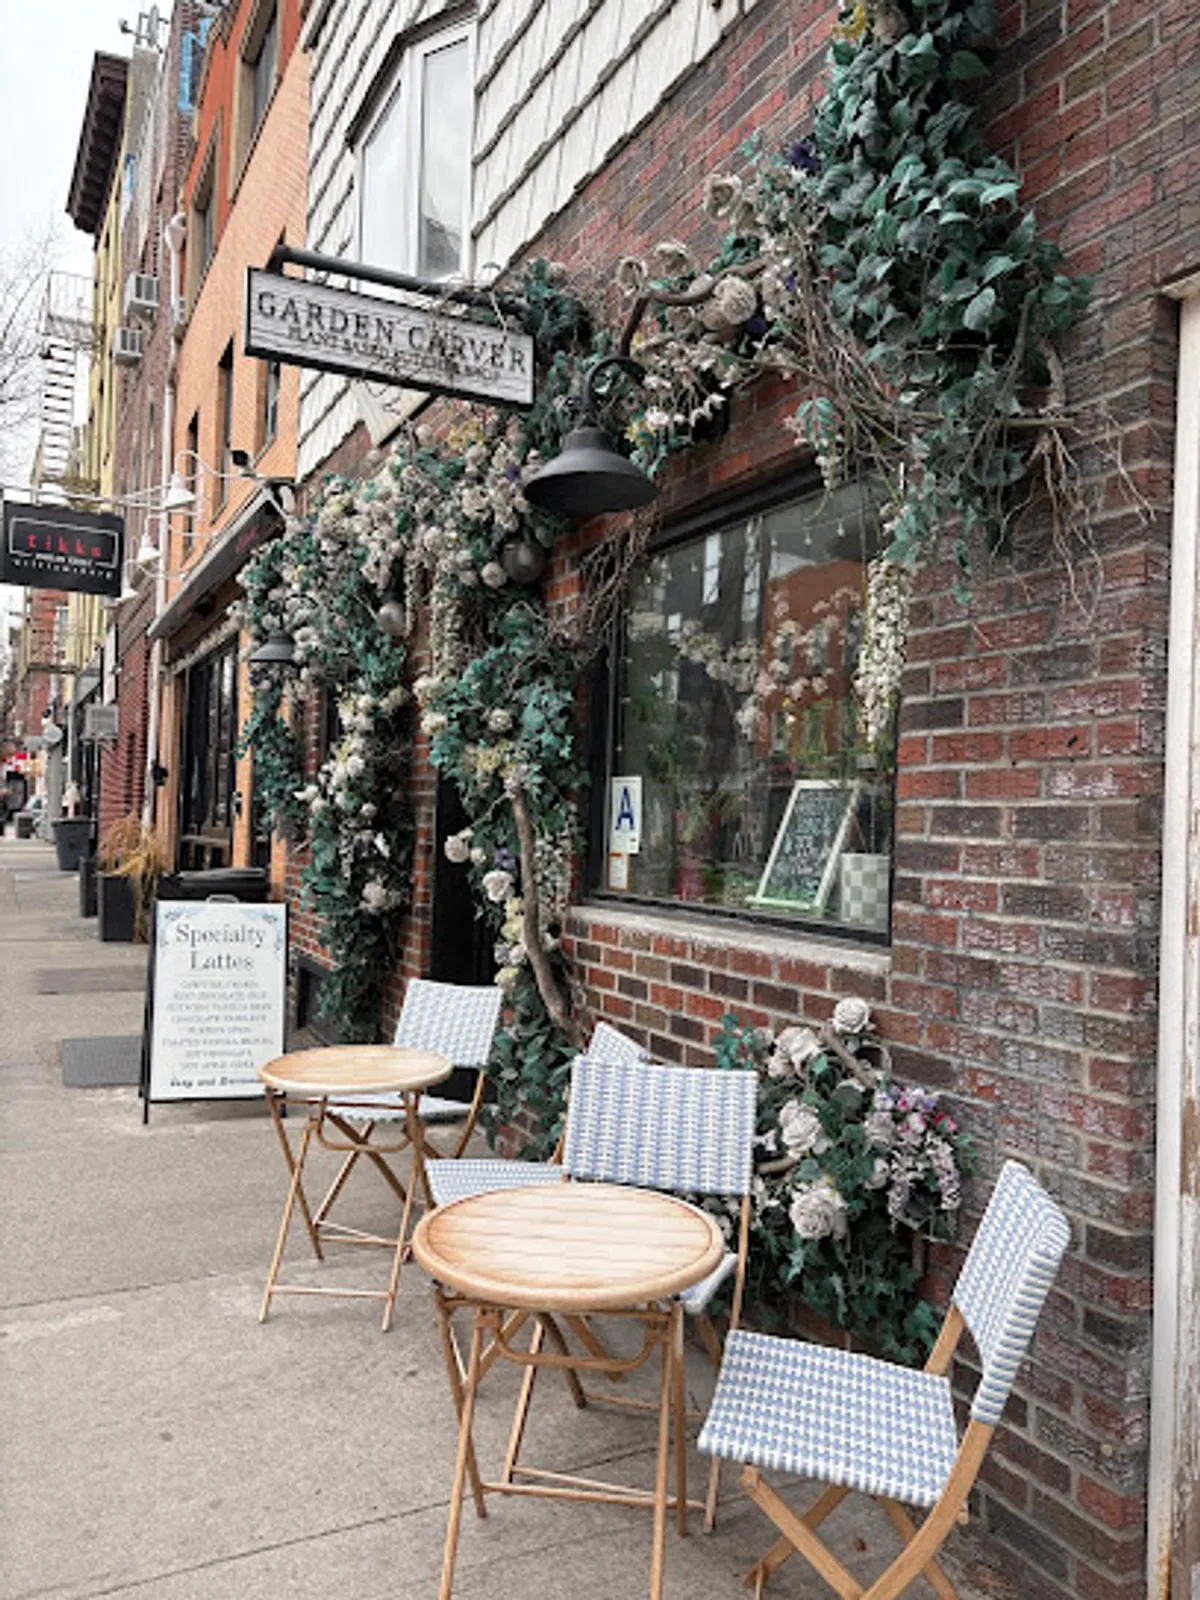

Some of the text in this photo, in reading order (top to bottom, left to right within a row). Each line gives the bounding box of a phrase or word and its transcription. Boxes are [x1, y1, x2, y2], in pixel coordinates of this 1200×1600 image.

[257, 291, 528, 375] GARDEN CARVER
[614, 786, 634, 831] A
[176, 923, 266, 949] Specialty
[190, 951, 254, 970] Lattes
